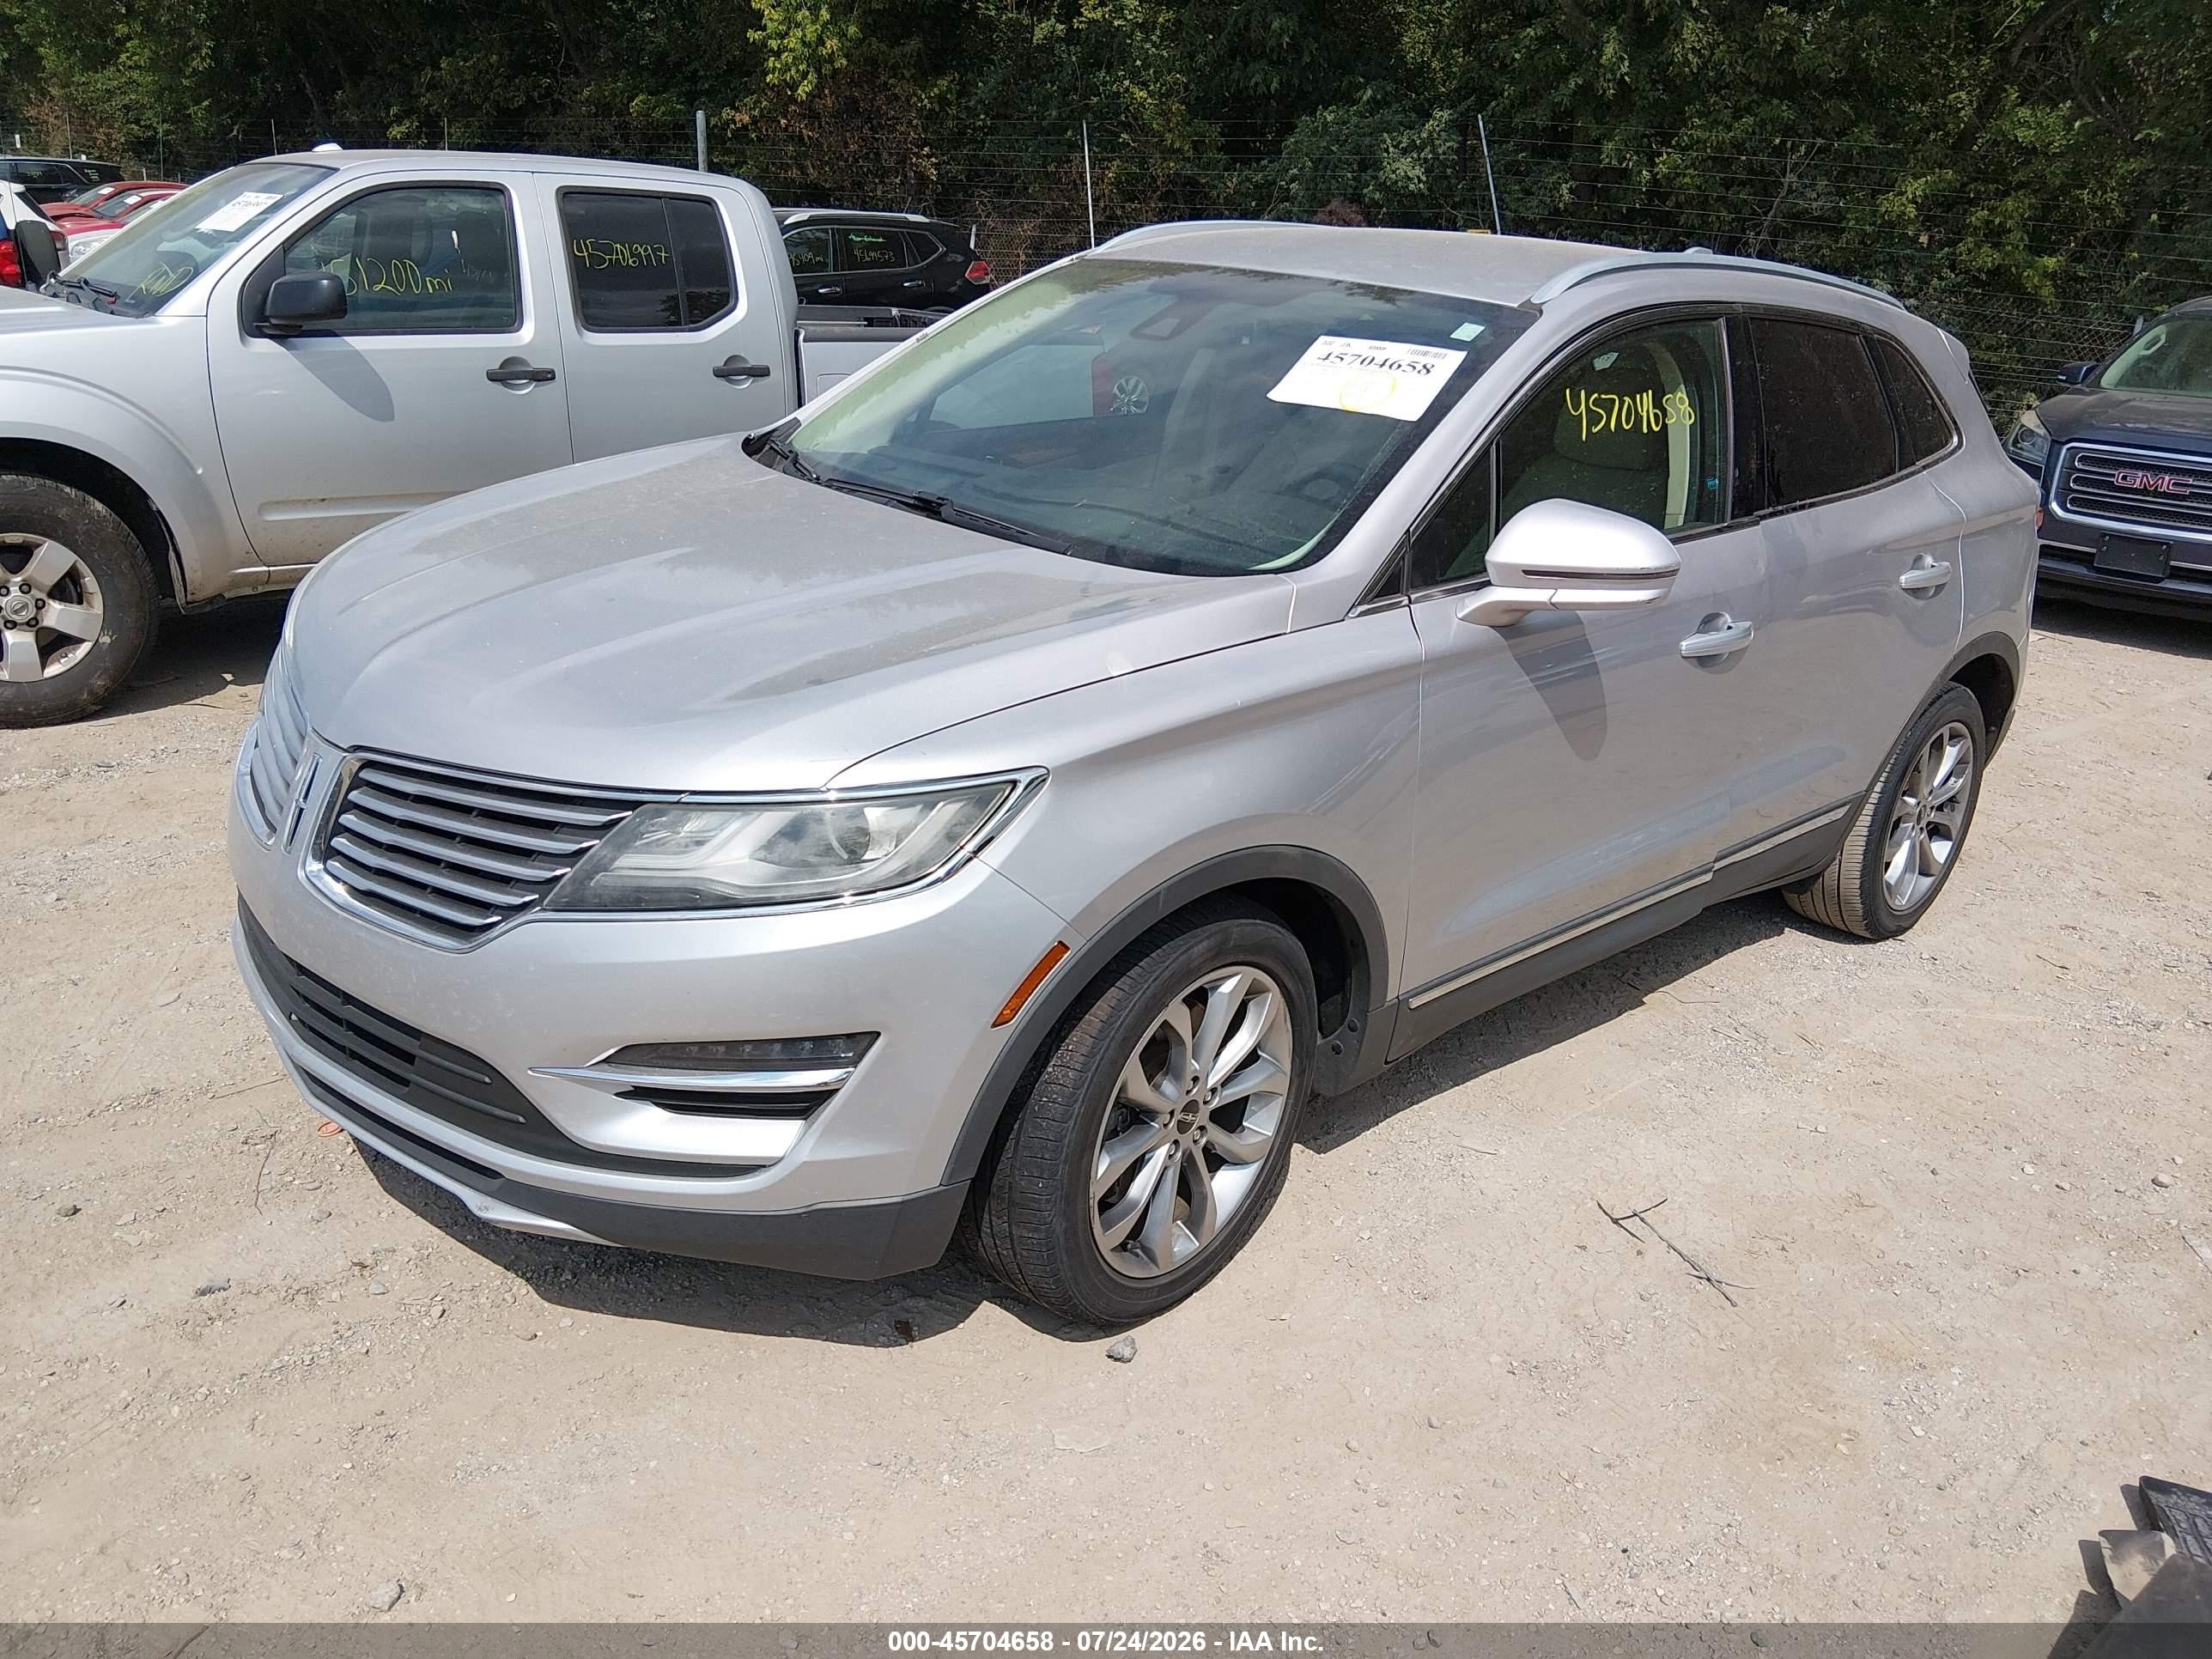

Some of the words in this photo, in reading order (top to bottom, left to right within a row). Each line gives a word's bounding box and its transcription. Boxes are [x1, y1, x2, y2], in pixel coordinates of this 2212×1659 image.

[573, 239, 671, 269] 45706997
[1316, 350, 1437, 376] 45704658
[1565, 388, 1696, 442] 45704658
[2114, 470, 2193, 495] GMC
